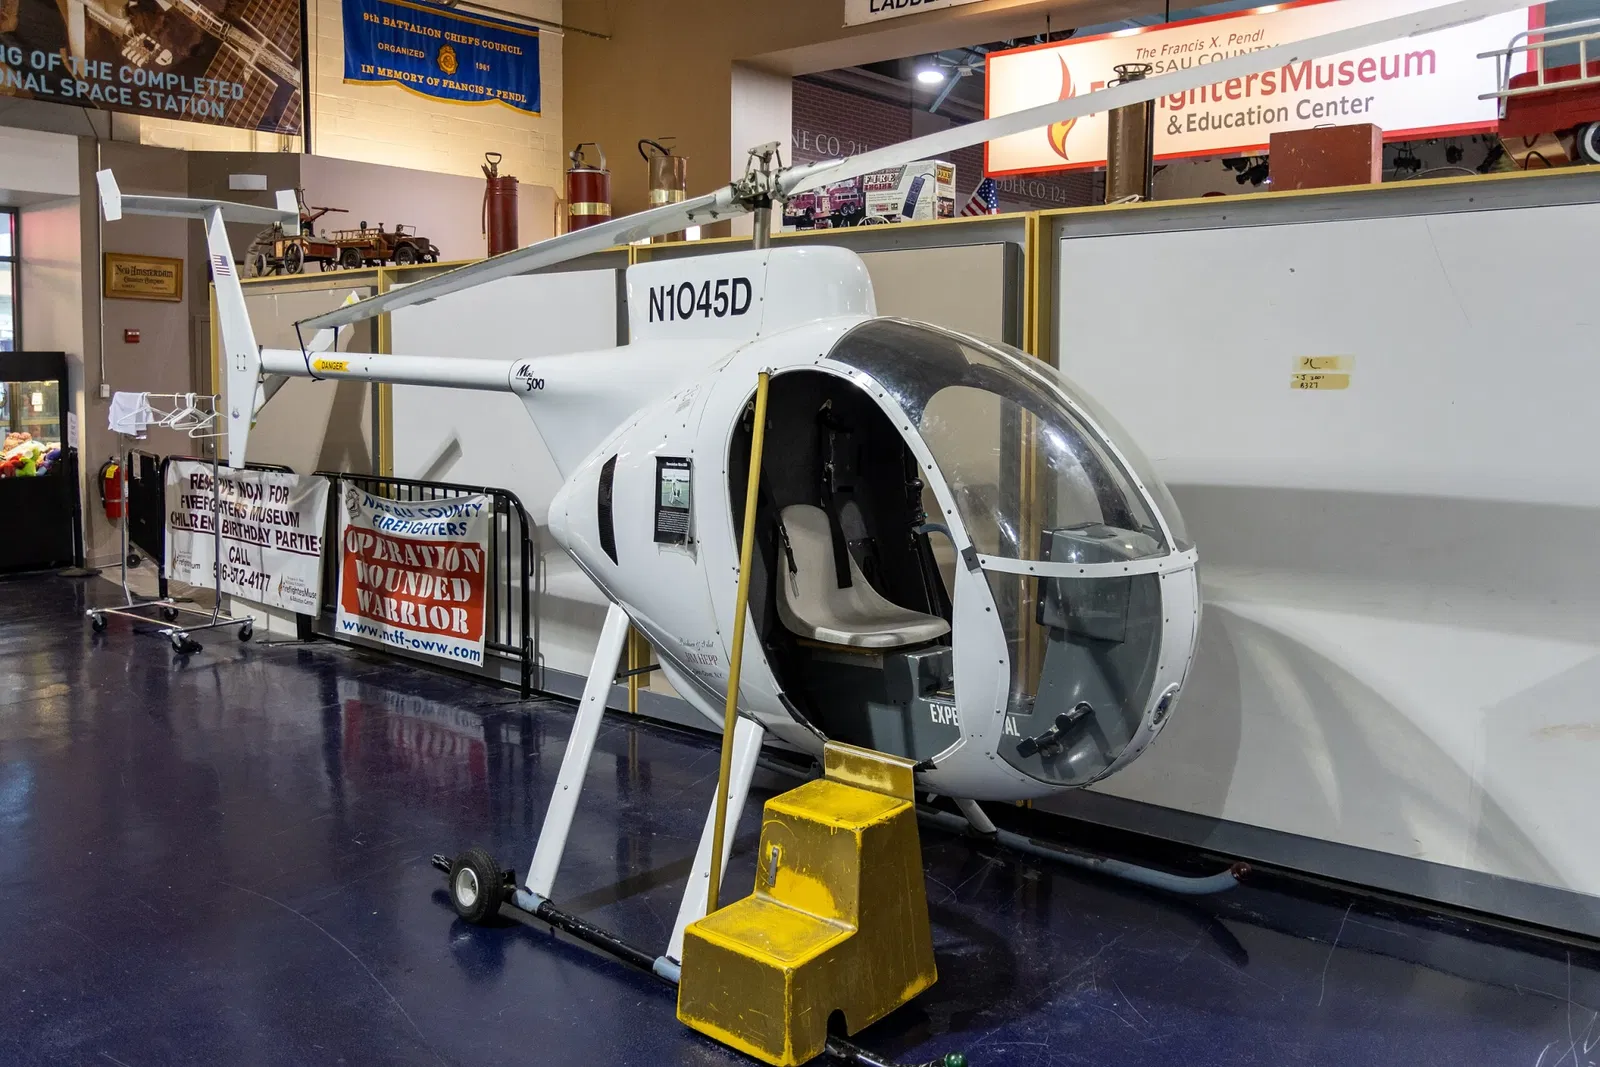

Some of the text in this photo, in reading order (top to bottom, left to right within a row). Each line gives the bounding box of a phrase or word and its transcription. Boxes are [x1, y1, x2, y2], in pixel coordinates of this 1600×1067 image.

[363, 12, 523, 56] 9th BATTALION CHIEFS COUNCIL
[1136, 29, 1265, 60] The Francis X. Pendl
[378, 42, 425, 59] ORGANIZED
[30, 50, 62, 72] OF
[67, 56, 112, 81] THE
[119, 65, 244, 100] COMPLETED
[361, 64, 375, 74] IN
[377, 67, 425, 84] MEMORY
[426, 76, 440, 87] OF
[442, 80, 488, 96] FRANCIS
[496, 89, 528, 104] PENDL
[60, 78, 133, 106] SPACE
[138, 90, 225, 118] STATION
[1166, 95, 1375, 135] & Education Center
[815, 133, 844, 157] CO.
[649, 277, 752, 323] N1045D
[321, 361, 344, 370] DANGER
[526, 377, 545, 392] 500
[269, 485, 290, 504] FOR
[249, 506, 300, 528] MUSEUM
[372, 514, 467, 537] FIREFIGHTERS
[418, 503, 483, 520] COUNTY
[221, 519, 271, 545] BIRTHDAY
[228, 545, 251, 567] CALL
[346, 530, 481, 574] OPERATION
[355, 559, 471, 603] WOUNDED
[356, 588, 470, 634] WARRIOR
[342, 619, 481, 662] www.ncff-oww.com
